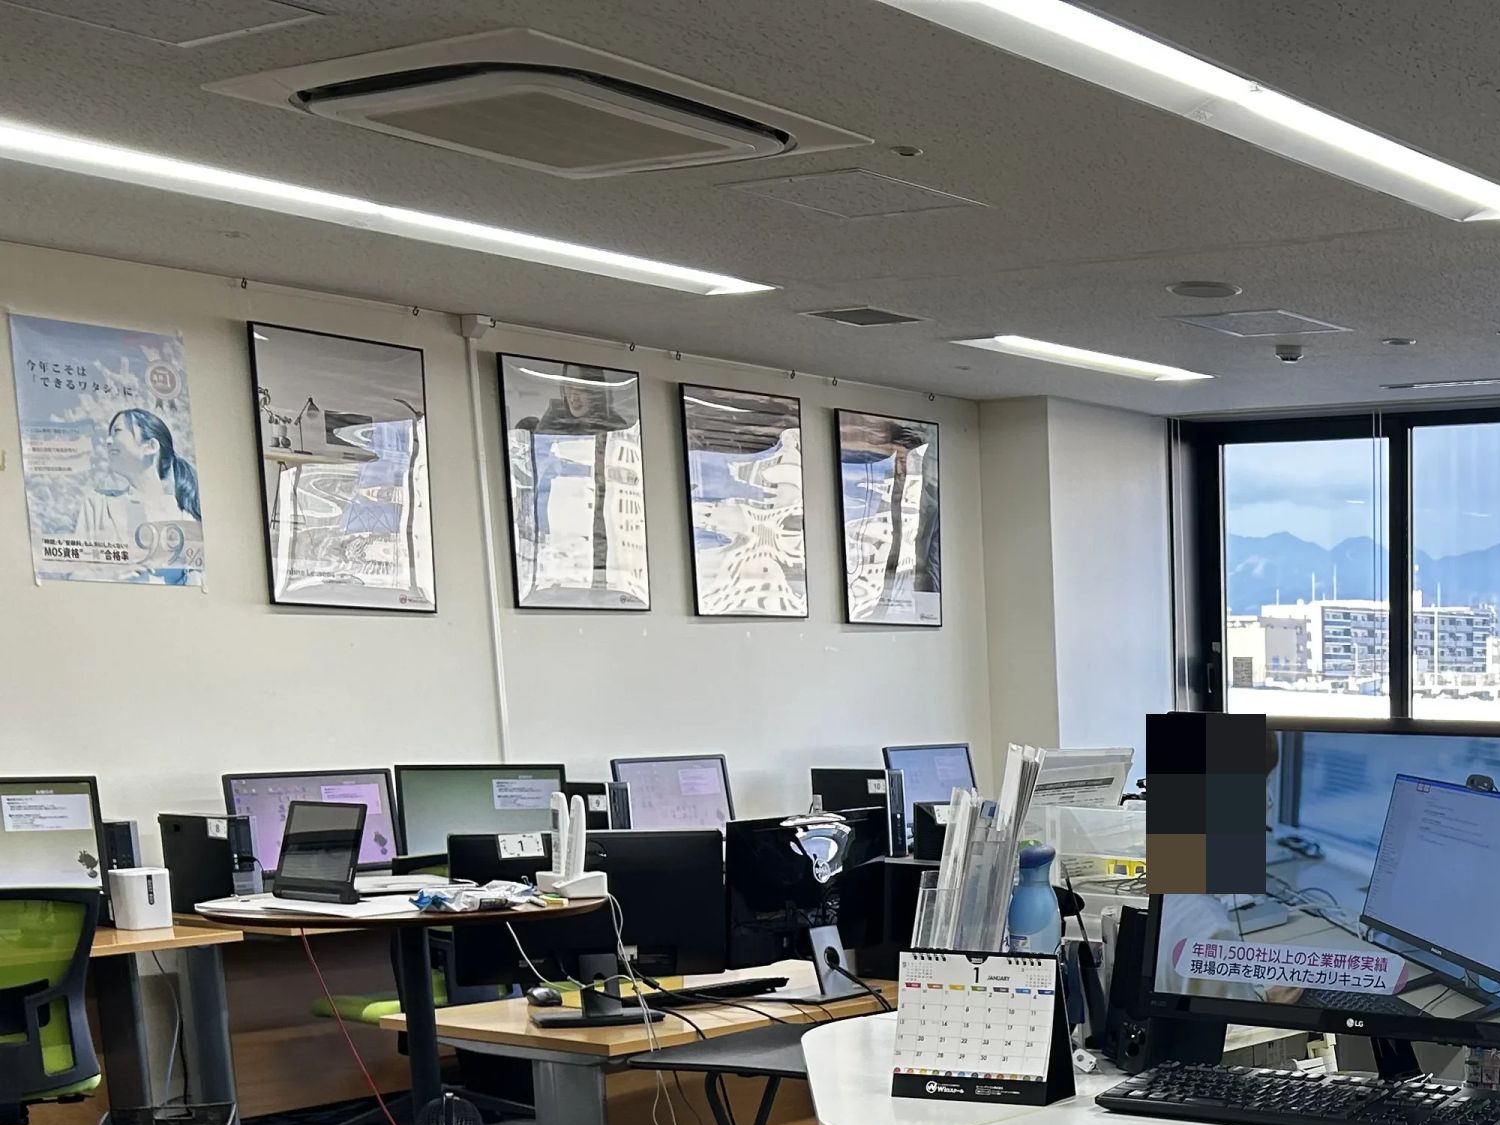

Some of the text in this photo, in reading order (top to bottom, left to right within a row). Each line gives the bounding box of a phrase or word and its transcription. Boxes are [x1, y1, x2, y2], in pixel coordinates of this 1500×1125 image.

[26, 359, 87, 377] 今年こそは
[518, 840, 525, 852] 1
[1192, 942, 1389, 972] 年間1,500社以上の企業研修実績
[973, 967, 980, 983] 1
[1190, 959, 1387, 990] 現場の声を取り入れたカリキュラム
[1355, 1020, 1364, 1028] LG
